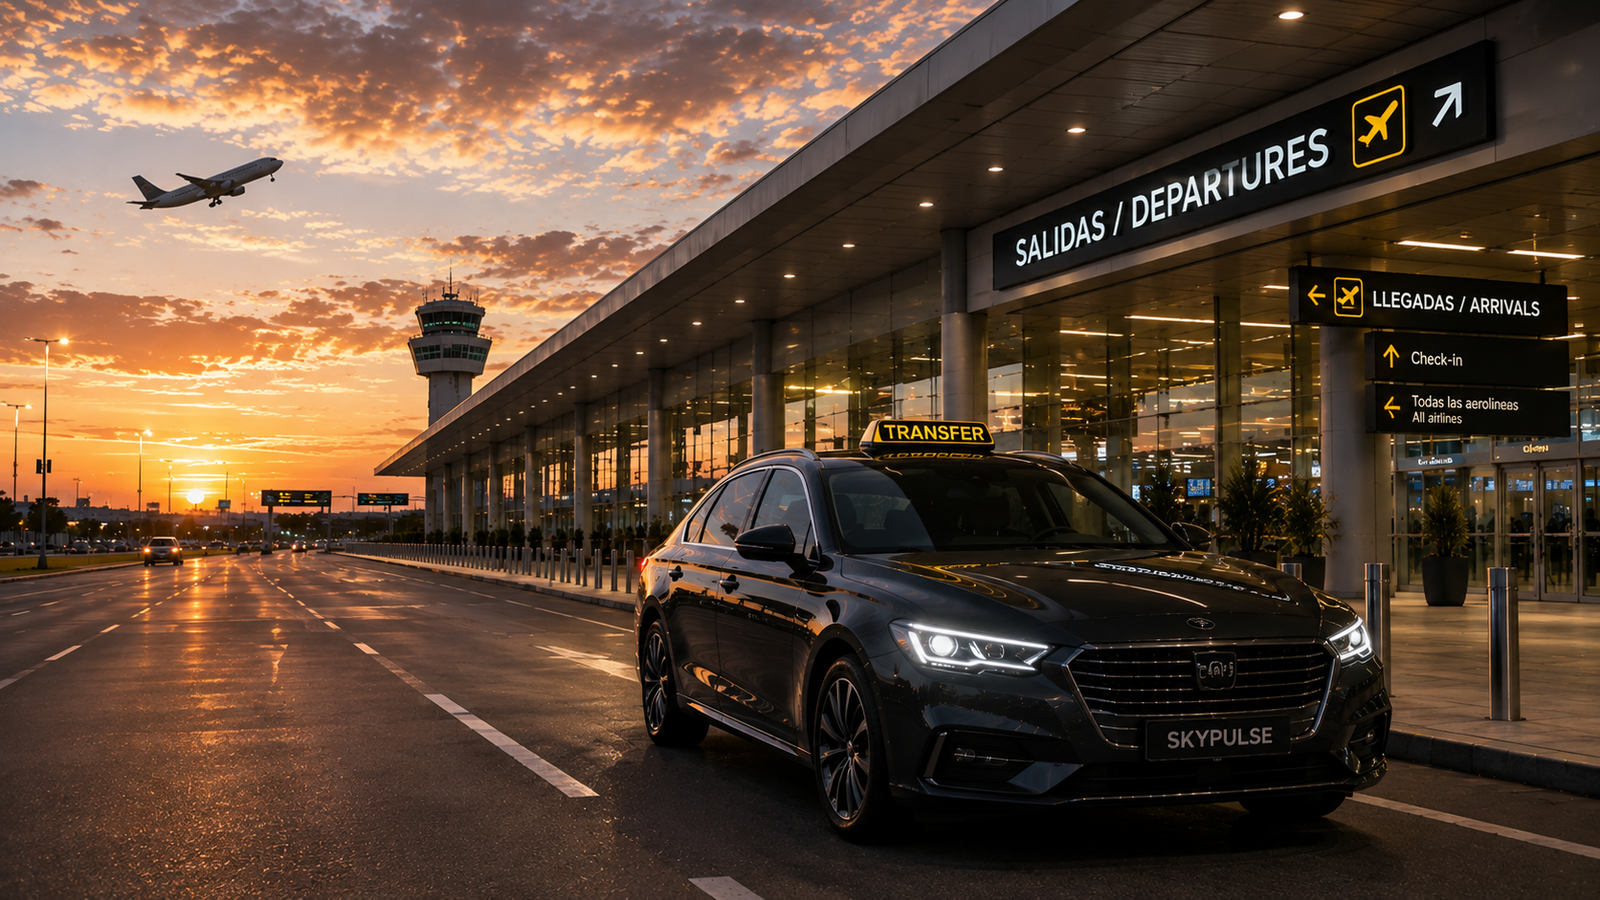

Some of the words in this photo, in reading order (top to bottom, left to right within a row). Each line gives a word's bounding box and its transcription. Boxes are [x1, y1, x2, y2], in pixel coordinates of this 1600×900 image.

[1015, 210, 1106, 267] SALIDAS
[1112, 201, 1124, 237] /
[1131, 127, 1330, 229] DEPARTURES
[1373, 290, 1455, 312] LLEGADAS
[1458, 295, 1467, 313] /
[1469, 297, 1541, 317] ARRIVALS
[1411, 351, 1463, 367] Check-in
[1411, 395, 1445, 408] Todas
[1447, 396, 1463, 409] las
[1465, 398, 1519, 411] aerolineas
[1412, 411, 1425, 423] All
[883, 424, 985, 441] TRANSFER
[1166, 726, 1274, 749] SKYPULSE
